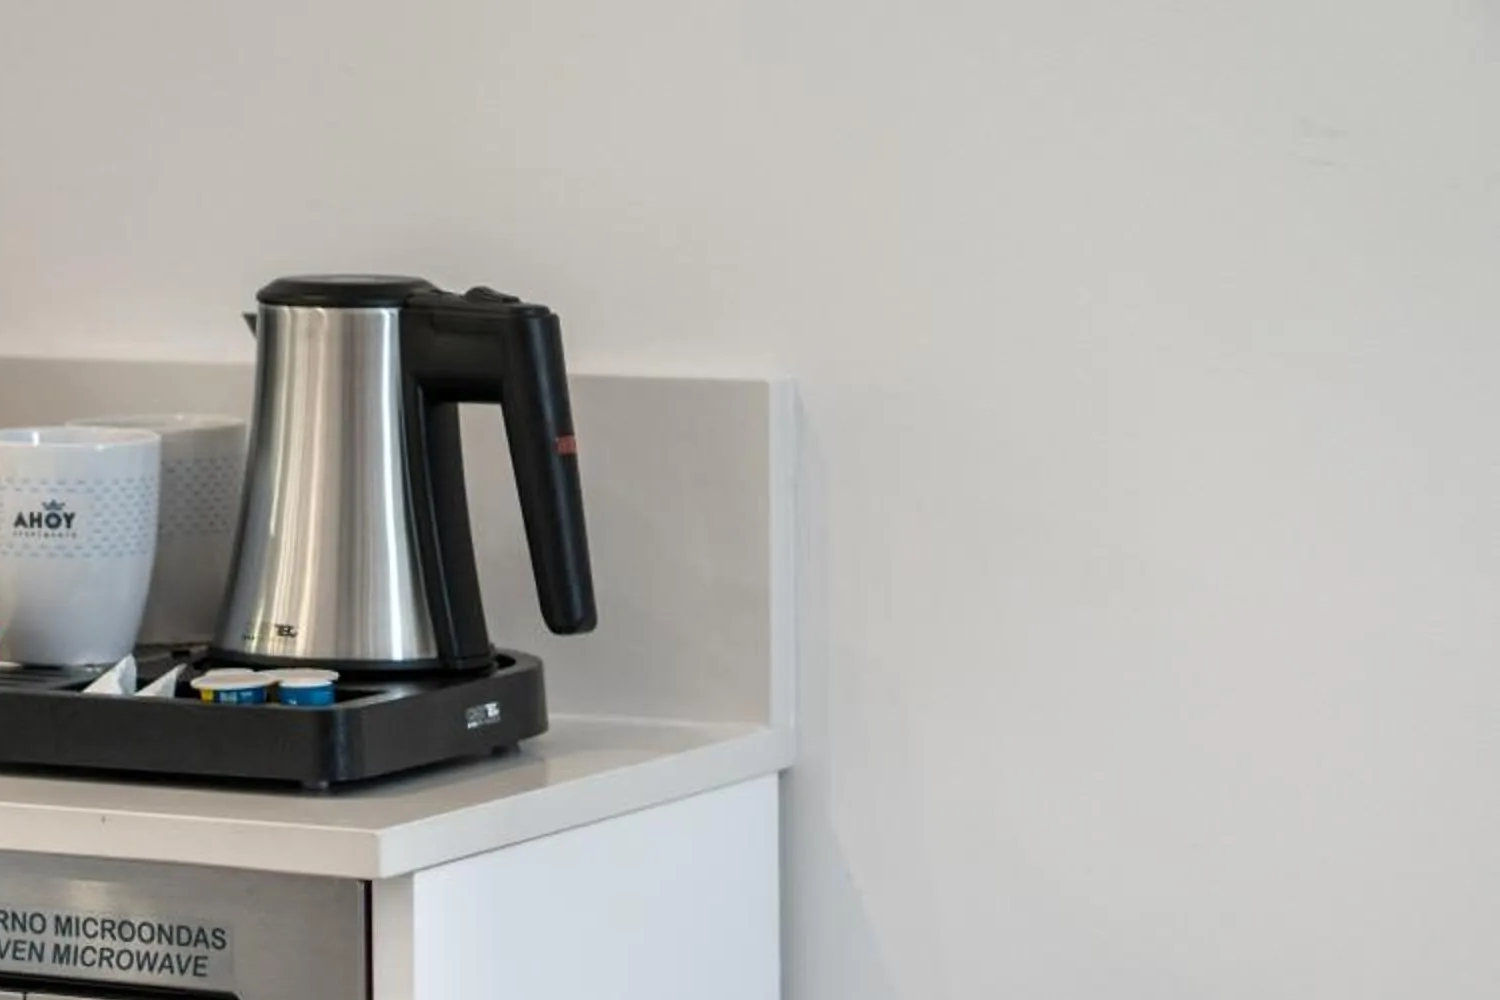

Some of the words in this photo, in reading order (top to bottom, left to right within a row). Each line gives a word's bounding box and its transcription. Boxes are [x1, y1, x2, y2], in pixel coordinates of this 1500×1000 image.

[13, 511, 76, 529] AHOY
[54, 914, 227, 951] MICROONDAS
[51, 942, 209, 978] MICROWAVE
